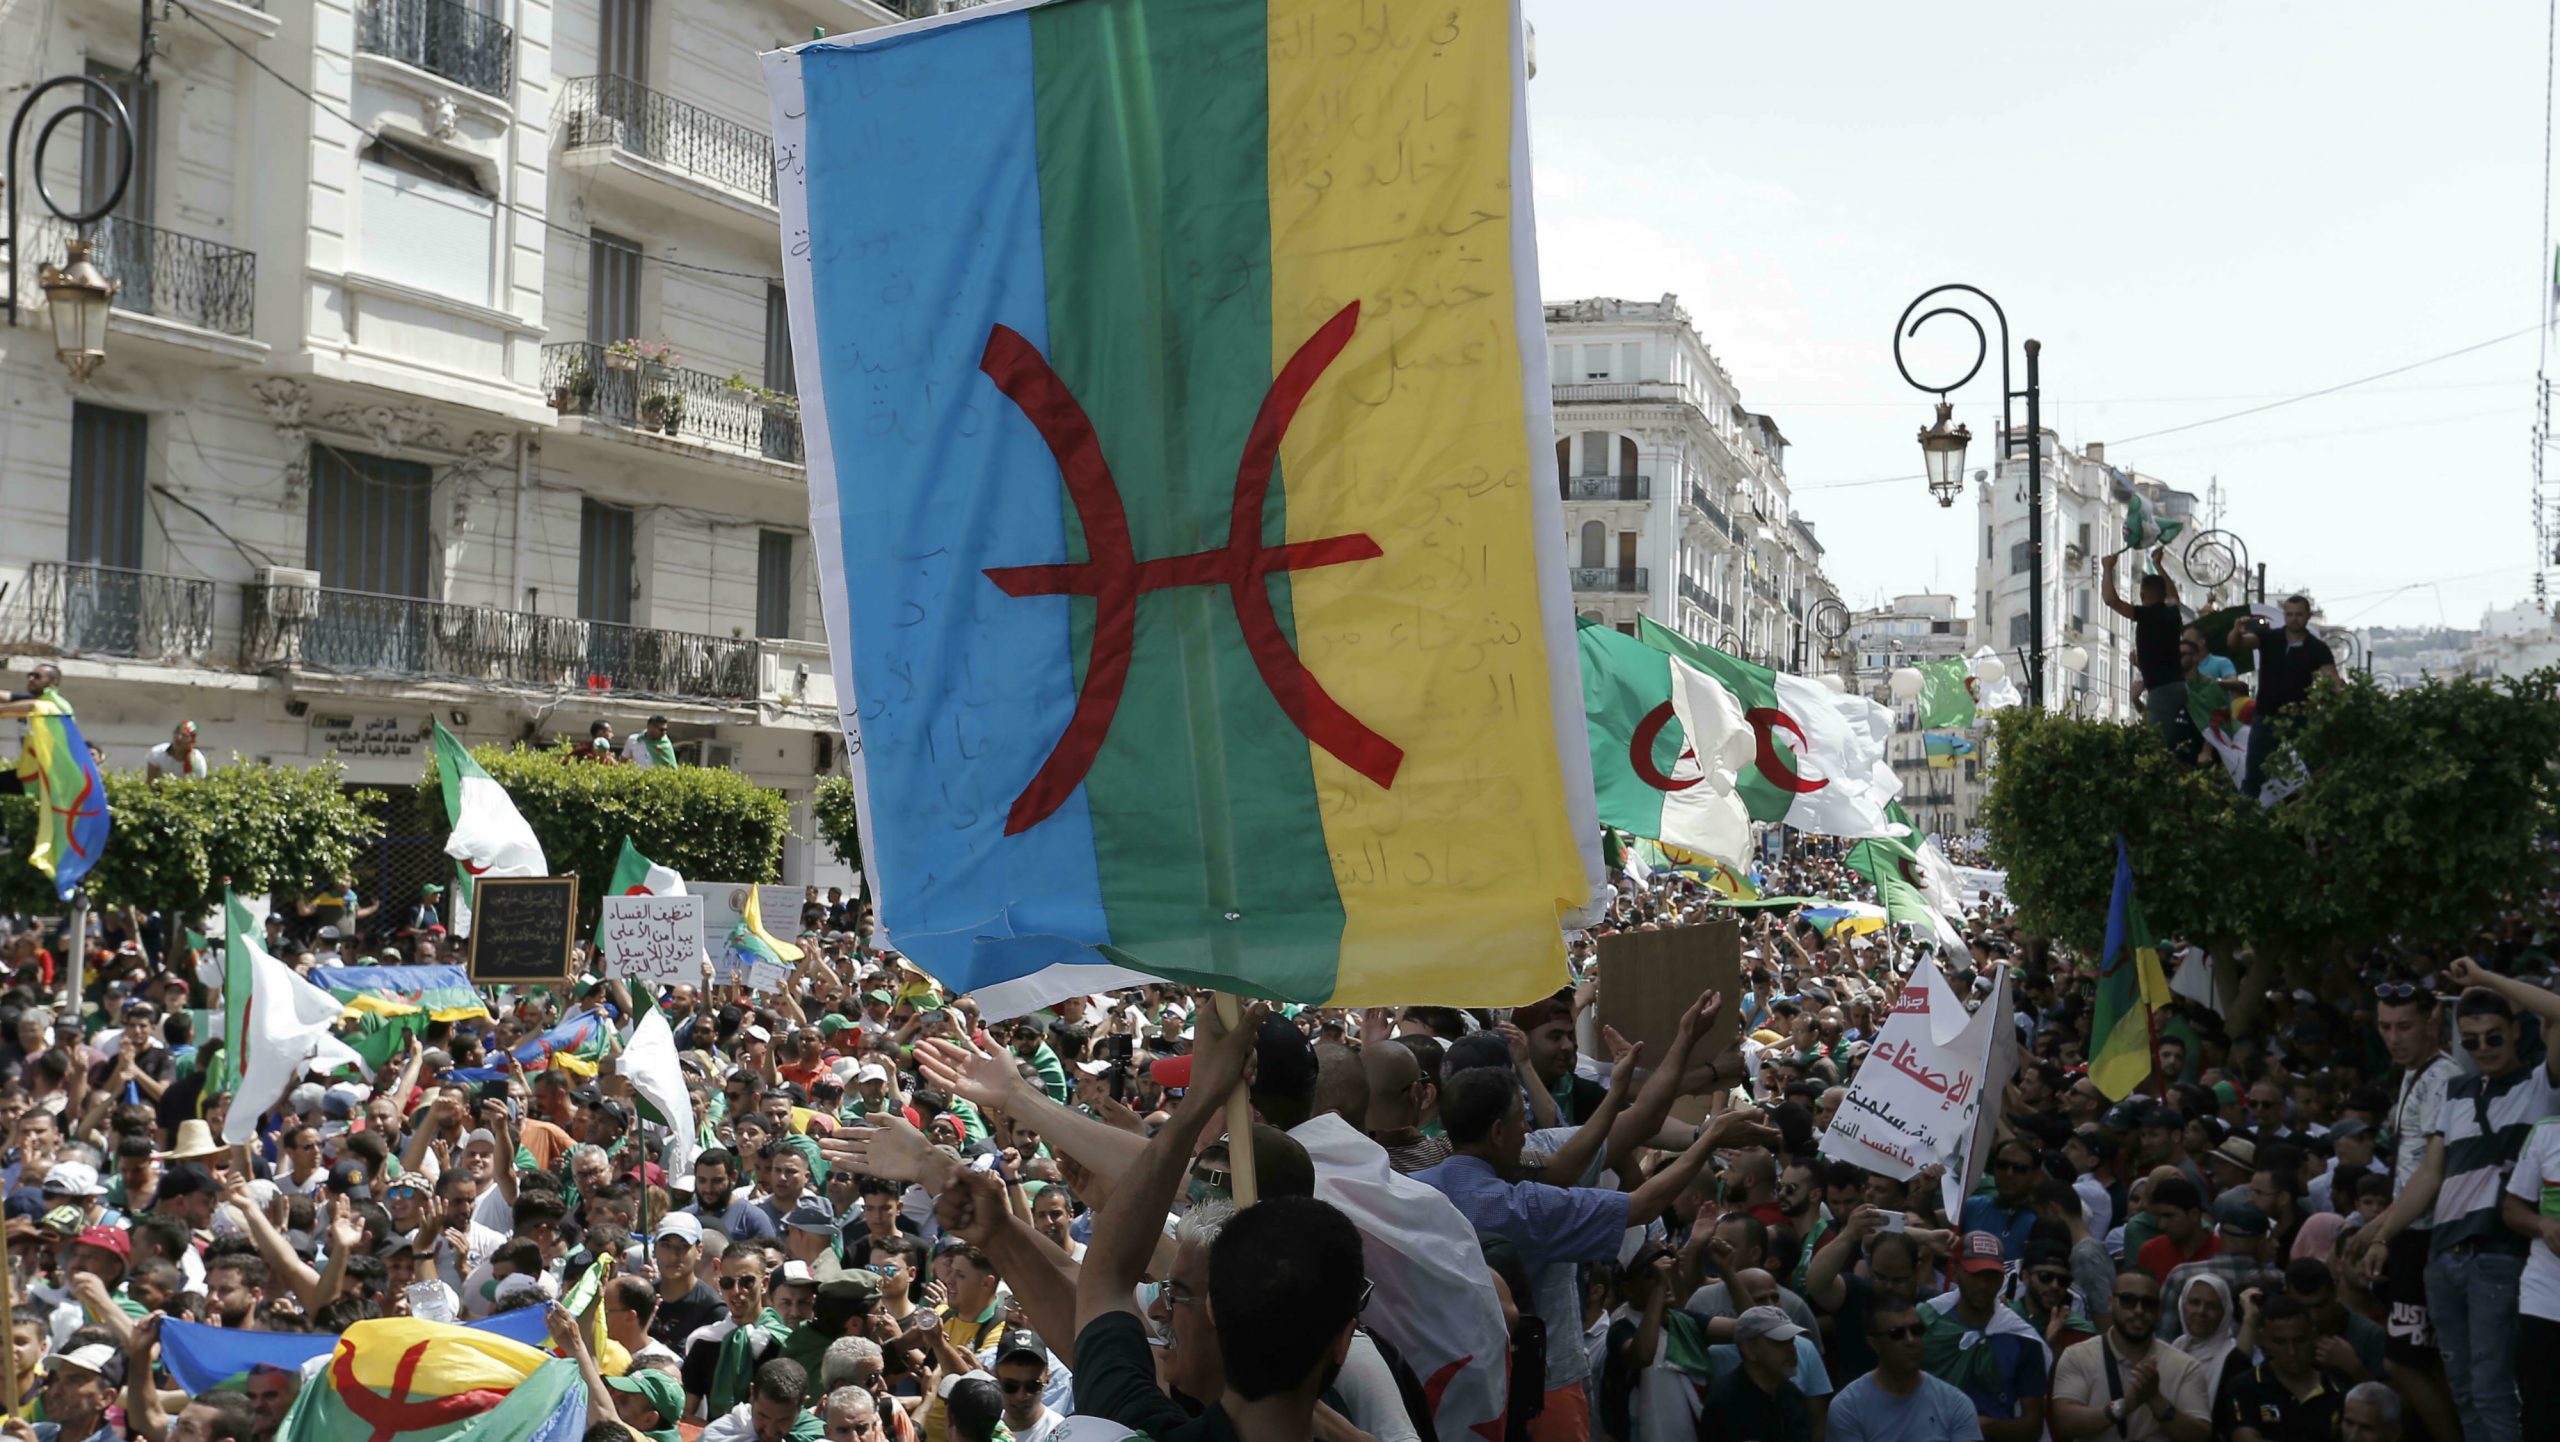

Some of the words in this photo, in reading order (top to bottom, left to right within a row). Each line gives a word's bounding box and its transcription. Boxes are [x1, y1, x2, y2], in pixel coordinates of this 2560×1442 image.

[609, 902, 651, 920] الفساد
[652, 903, 693, 922] تنظيف
[610, 921, 651, 941] الأعلى
[652, 930, 670, 943] من
[654, 959, 679, 978] مثل
[1872, 1039, 1974, 1112] الإصغاء
[1830, 1115, 1860, 1141] النية
[1859, 1134, 1900, 1157] تفسد
[1901, 1147, 1916, 1168] ما
[2392, 1301, 2427, 1327] JUST
